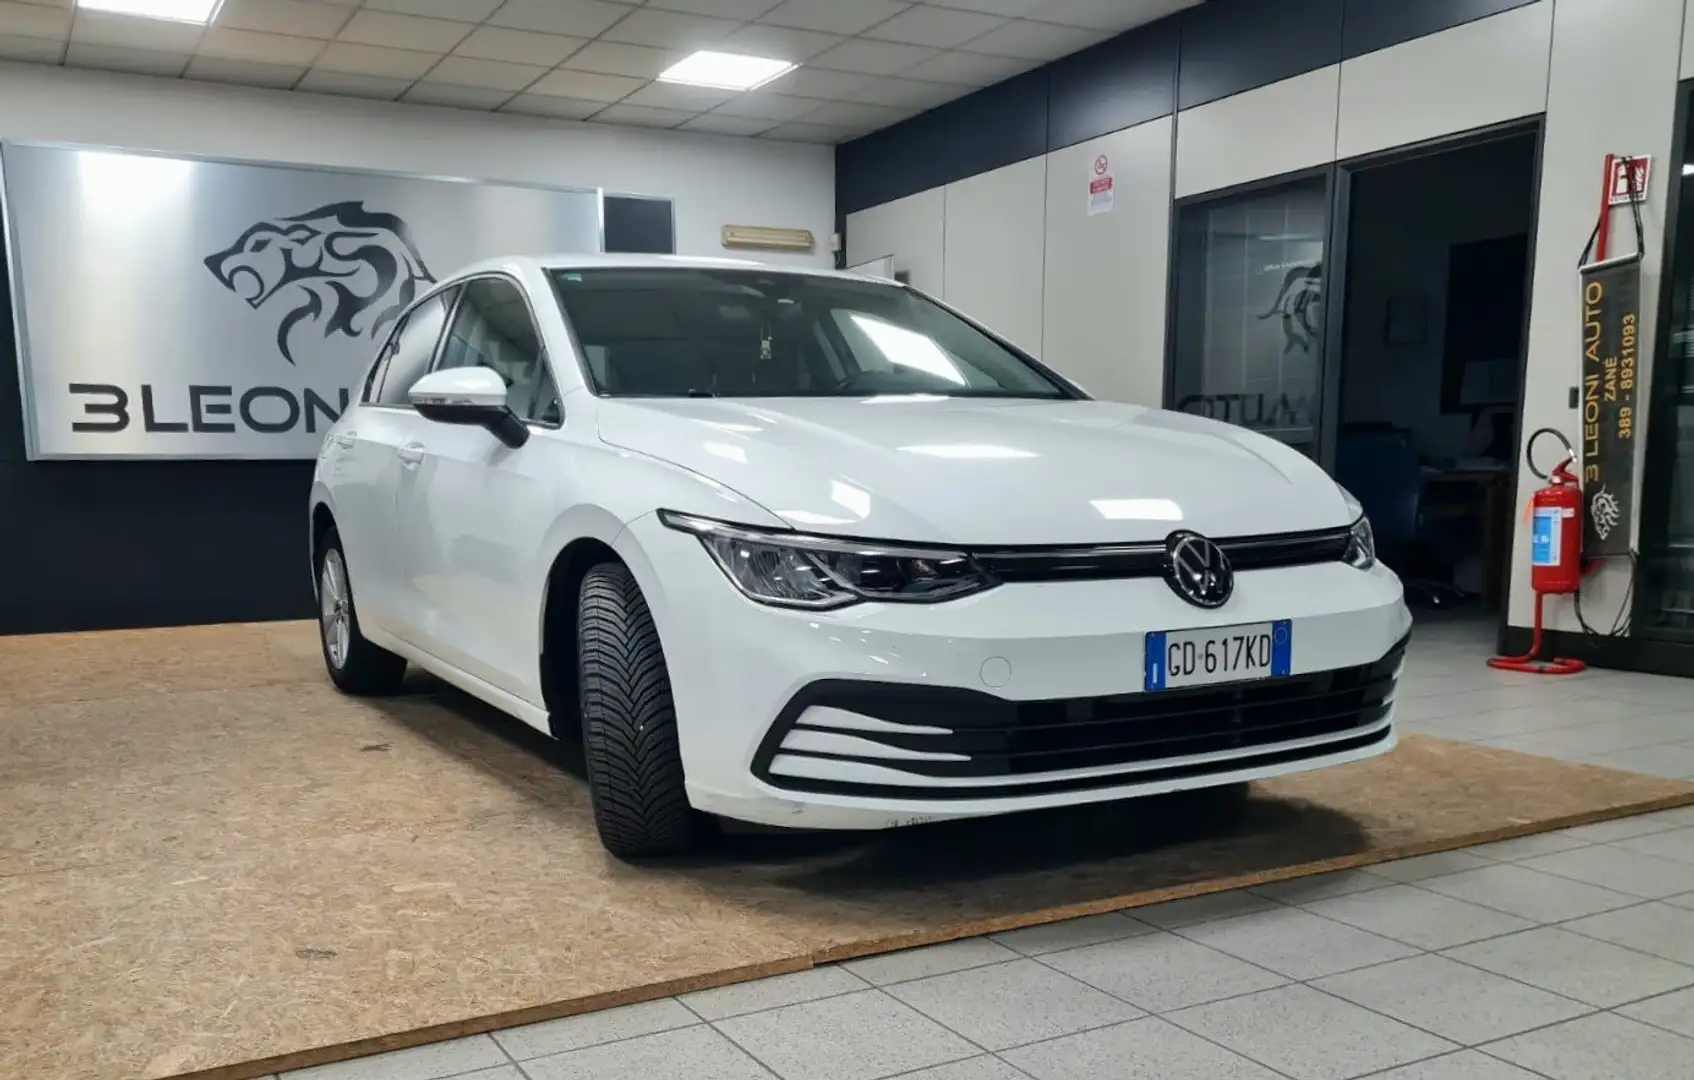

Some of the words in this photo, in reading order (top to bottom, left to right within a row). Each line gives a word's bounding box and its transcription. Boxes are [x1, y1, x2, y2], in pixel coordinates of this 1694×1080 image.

[1585, 282, 1603, 361] AUTO
[1620, 313, 1636, 389] 8931093
[140, 384, 349, 433] LEON
[1585, 375, 1600, 457] LEONI
[1619, 407, 1633, 439] 389
[1585, 464, 1599, 483] 3
